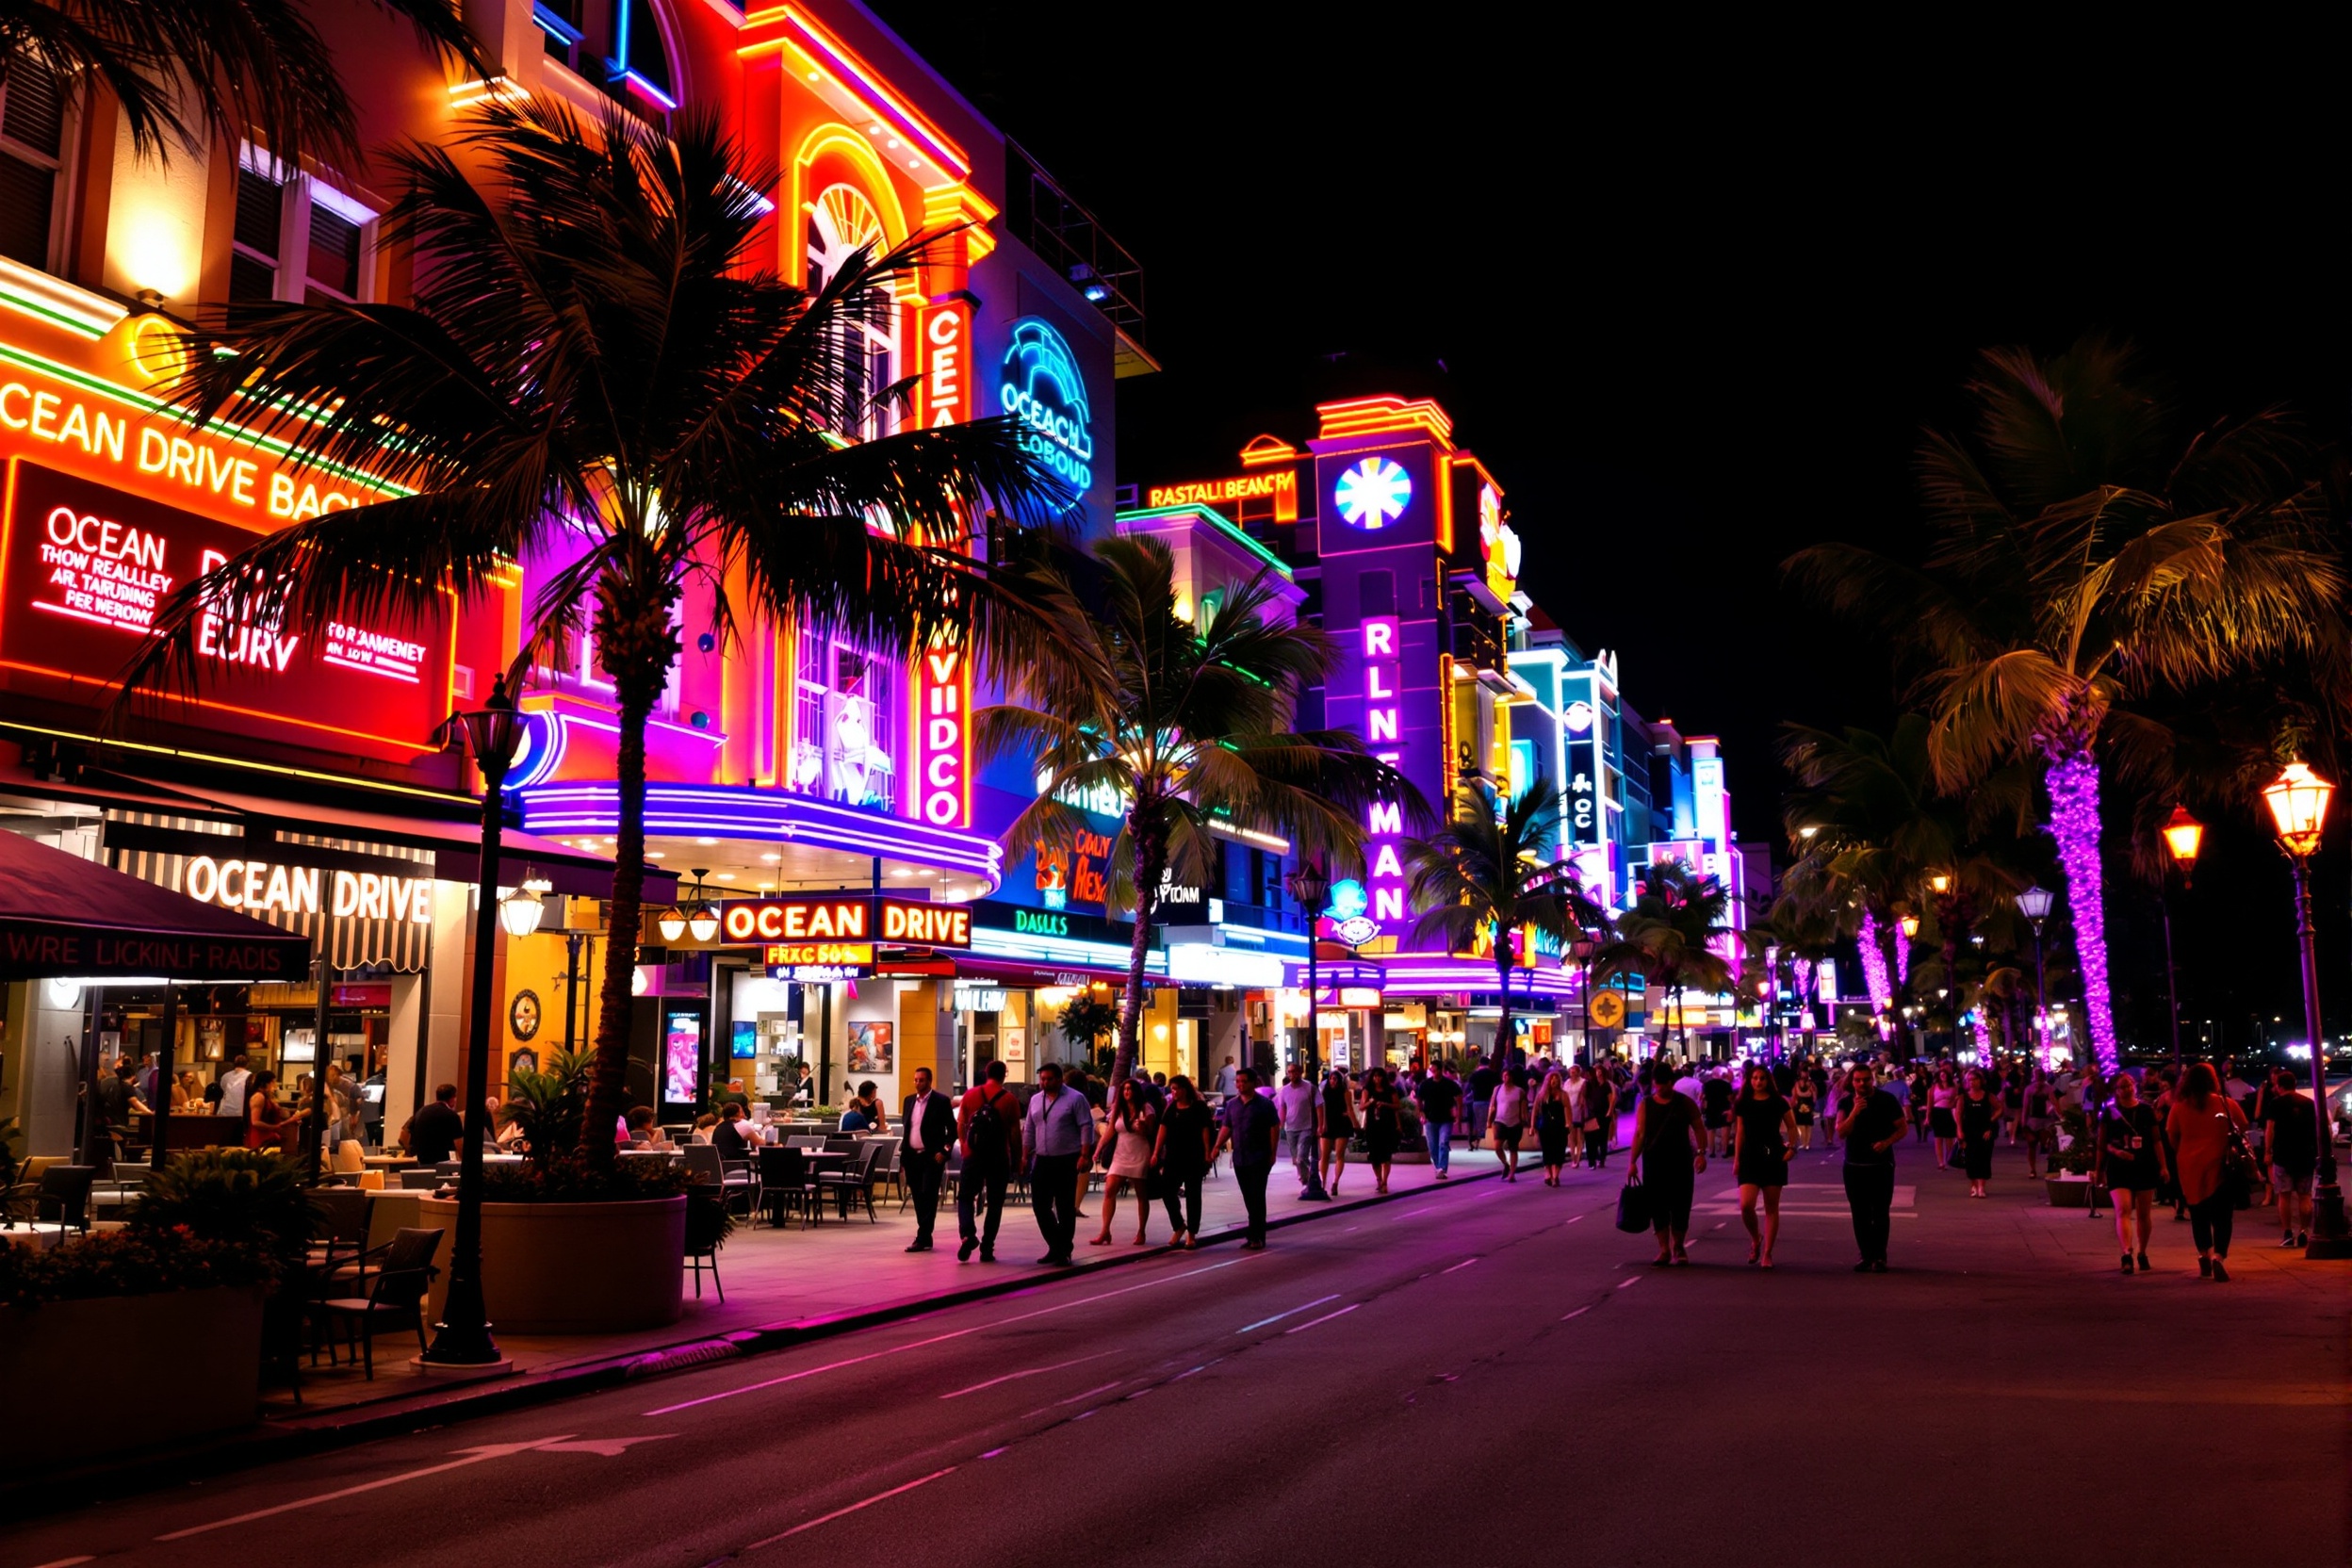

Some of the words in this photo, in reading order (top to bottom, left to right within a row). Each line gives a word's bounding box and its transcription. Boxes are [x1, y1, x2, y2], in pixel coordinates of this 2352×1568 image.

[139, 427, 259, 505] DRIVE
[270, 472, 374, 521] BAC
[48, 507, 166, 571] OCEAN
[188, 856, 319, 914] OCEAN
[333, 870, 433, 924] DRIVE
[726, 905, 864, 939] OCEAN
[885, 905, 970, 943] DRIVE
